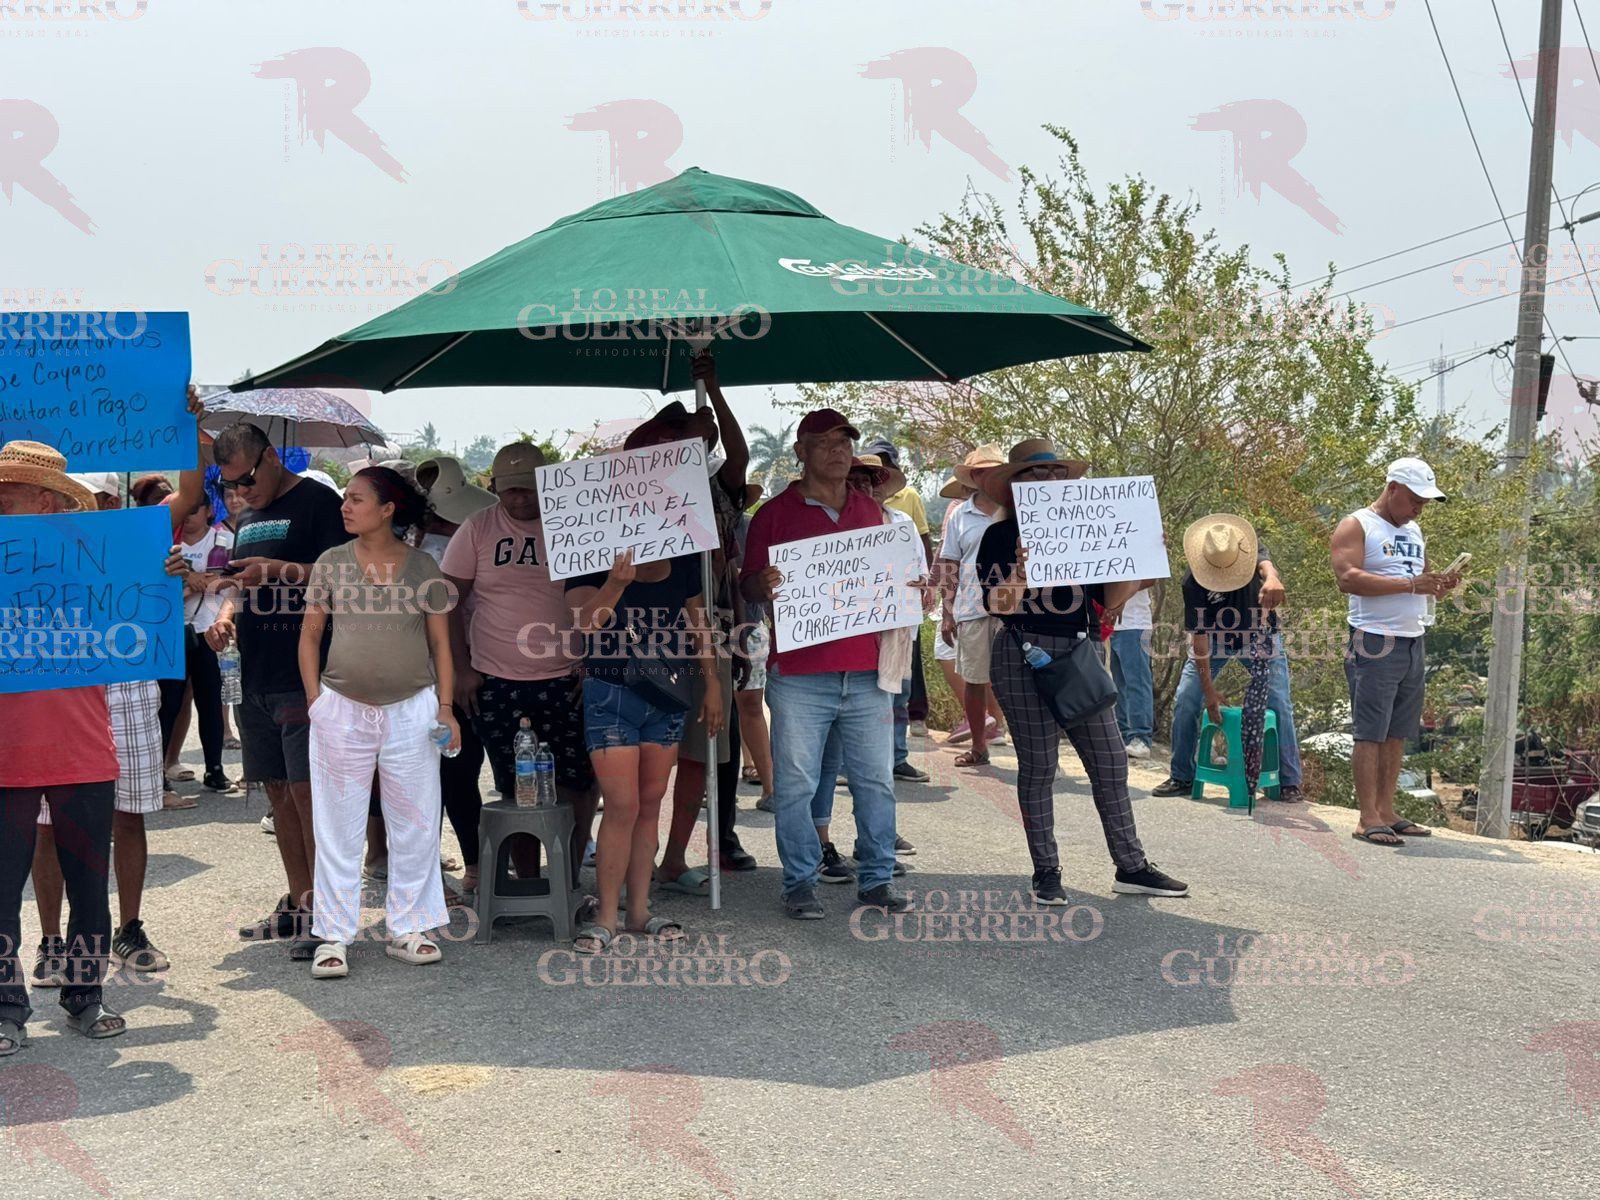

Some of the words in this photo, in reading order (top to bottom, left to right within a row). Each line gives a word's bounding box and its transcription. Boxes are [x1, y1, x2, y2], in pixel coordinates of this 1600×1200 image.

[778, 257, 937, 281] Carlsberg
[69, 395, 87, 417] el
[58, 425, 180, 458] Carretera
[542, 467, 576, 493] LOS
[1018, 485, 1051, 507] LOS
[1062, 480, 1156, 502] EJIDATARIOS
[543, 495, 567, 514] DE
[576, 480, 664, 507] CAYACOS
[545, 501, 656, 531] SOLICITAN
[664, 492, 697, 511] EL
[1021, 511, 1040, 525] DE
[1047, 504, 1116, 521] CAYACOS
[551, 530, 605, 551] PAGO
[620, 523, 646, 538] DE
[658, 513, 687, 530] LA
[774, 547, 802, 564] LOS
[811, 525, 911, 557] EJIDATARIOS
[1022, 524, 1107, 539] SOLICITAN
[1113, 521, 1139, 535] EL
[494, 536, 549, 567] GA
[1026, 540, 1068, 556] PAGO
[1080, 541, 1102, 553] DE
[1107, 536, 1128, 550] LA
[805, 557, 870, 578] CAYACOS
[1030, 556, 1136, 582] CARRETERA
[776, 576, 866, 602] SOLICITAN
[873, 571, 894, 584] EL
[777, 602, 821, 623] PAGO
[832, 595, 857, 610] DE
[873, 585, 894, 601] LA
[792, 603, 897, 643] CARRETERA
